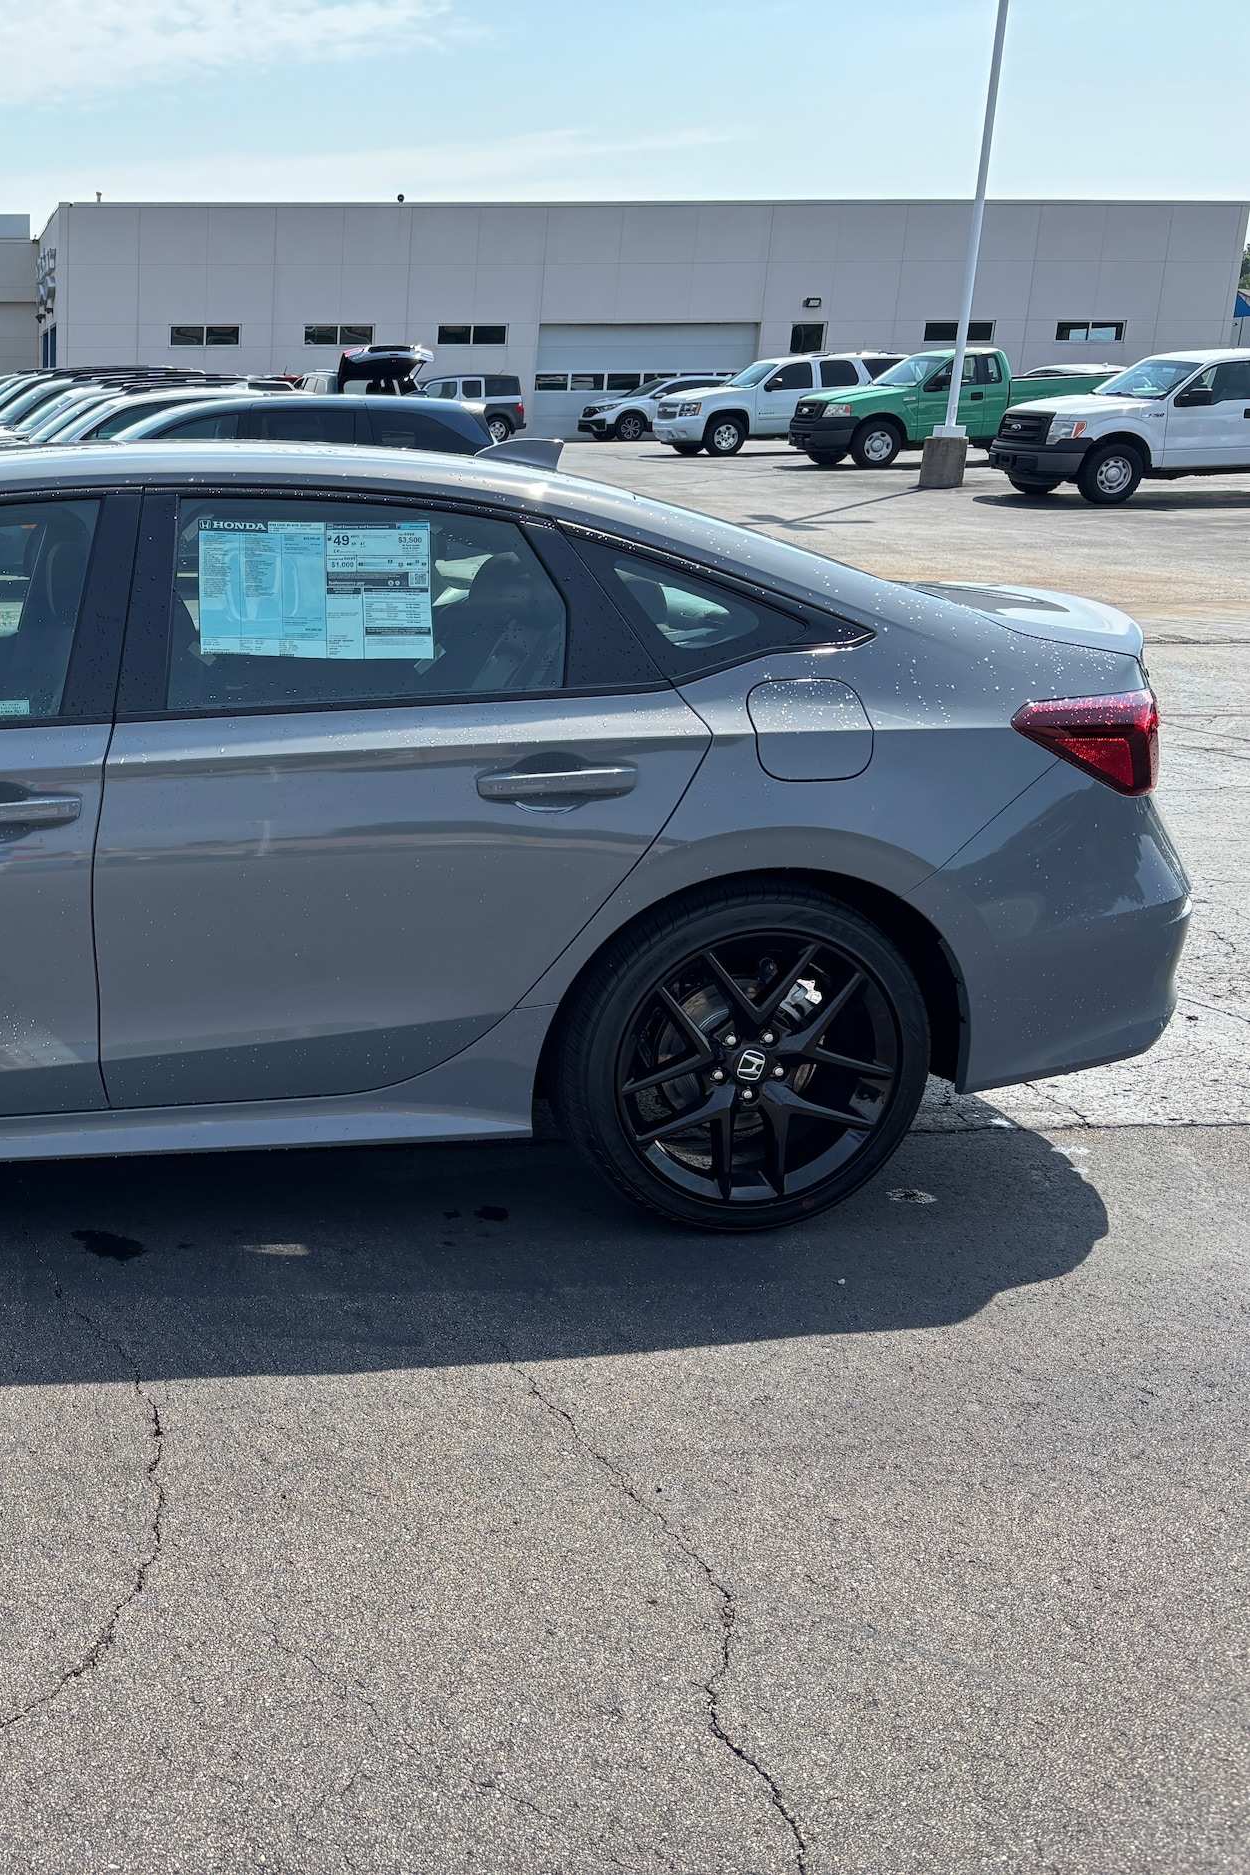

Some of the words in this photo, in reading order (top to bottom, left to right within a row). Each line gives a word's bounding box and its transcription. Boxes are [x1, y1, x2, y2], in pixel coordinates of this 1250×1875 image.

[212, 521, 267, 530] HONDA
[333, 535, 349, 546] 49
[331, 561, 354, 569] $1,000
